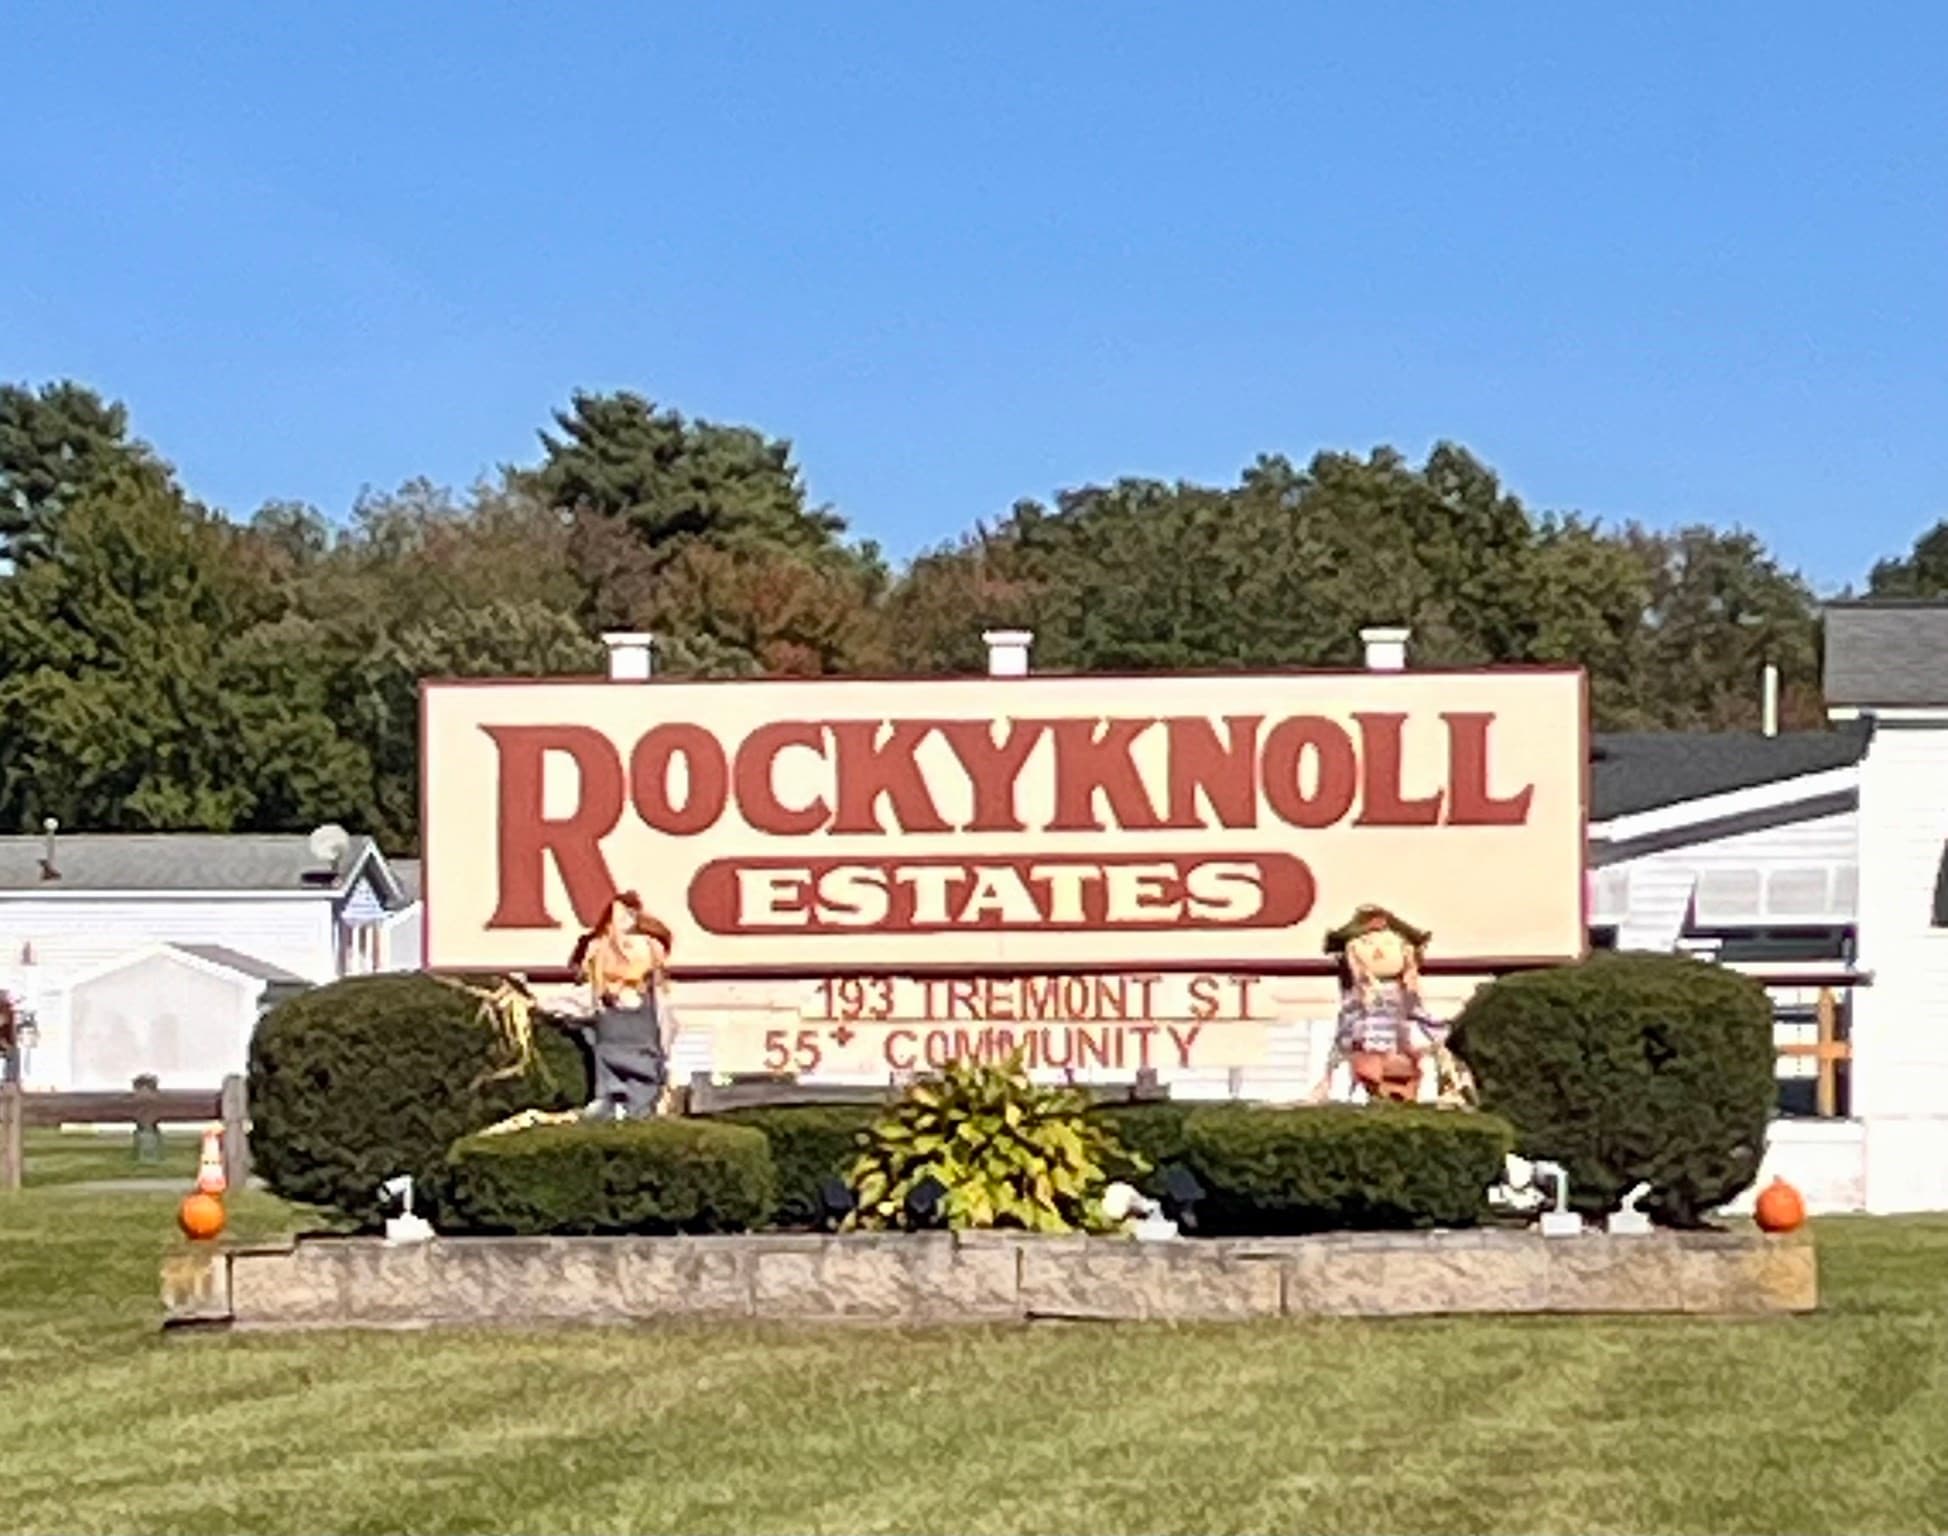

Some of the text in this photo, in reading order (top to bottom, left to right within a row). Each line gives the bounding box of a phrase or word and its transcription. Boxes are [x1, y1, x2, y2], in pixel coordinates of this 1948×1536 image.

[478, 712, 1535, 931] ROCKYKNOLL
[735, 862, 1264, 928] ESTATES
[815, 975, 1260, 1019] 193 TREMONT ST
[883, 1026, 1202, 1071] COMMUNITY
